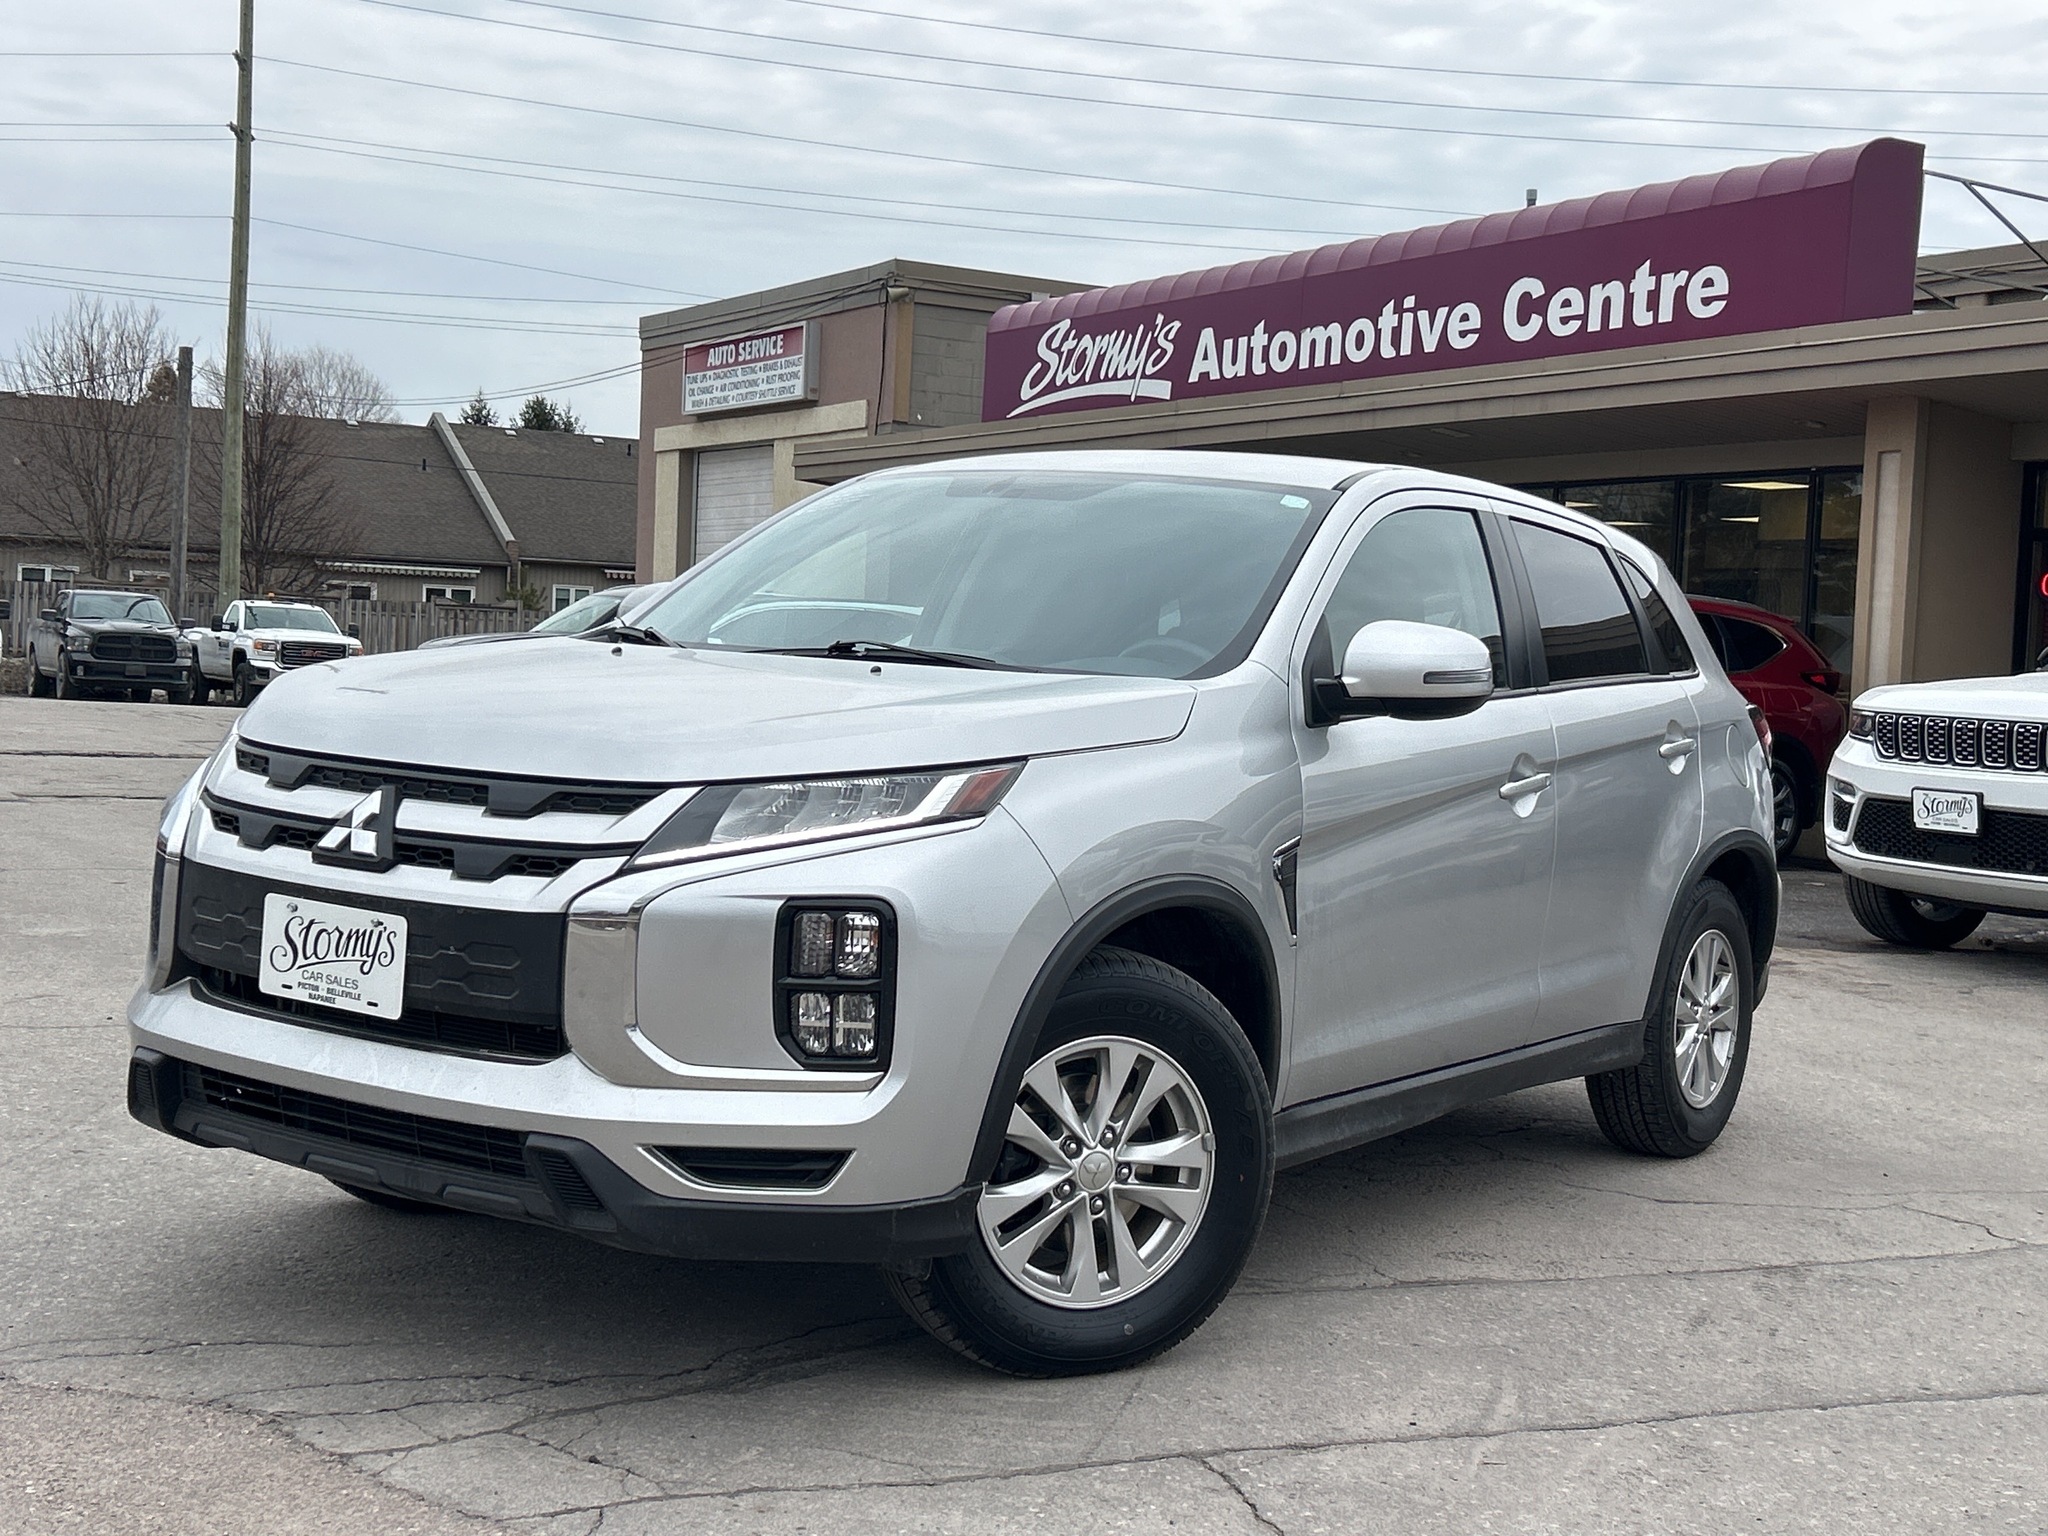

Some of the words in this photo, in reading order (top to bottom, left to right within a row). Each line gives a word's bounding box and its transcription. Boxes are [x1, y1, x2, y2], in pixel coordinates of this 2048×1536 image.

[1019, 313, 1182, 402] Stormy's
[1188, 295, 1482, 383] Automotive
[1502, 258, 1730, 342] Centre
[707, 344, 736, 367] AUTO
[738, 334, 784, 362] SERVICE
[1917, 793, 1973, 819] Stormy's
[270, 915, 397, 975] Stormy's
[298, 981, 319, 992] PICTON
[326, 987, 361, 1001] BELLEVILLE
[302, 969, 323, 982] CAR
[325, 974, 359, 990] SALES
[308, 993, 336, 1004] NAPANEE
